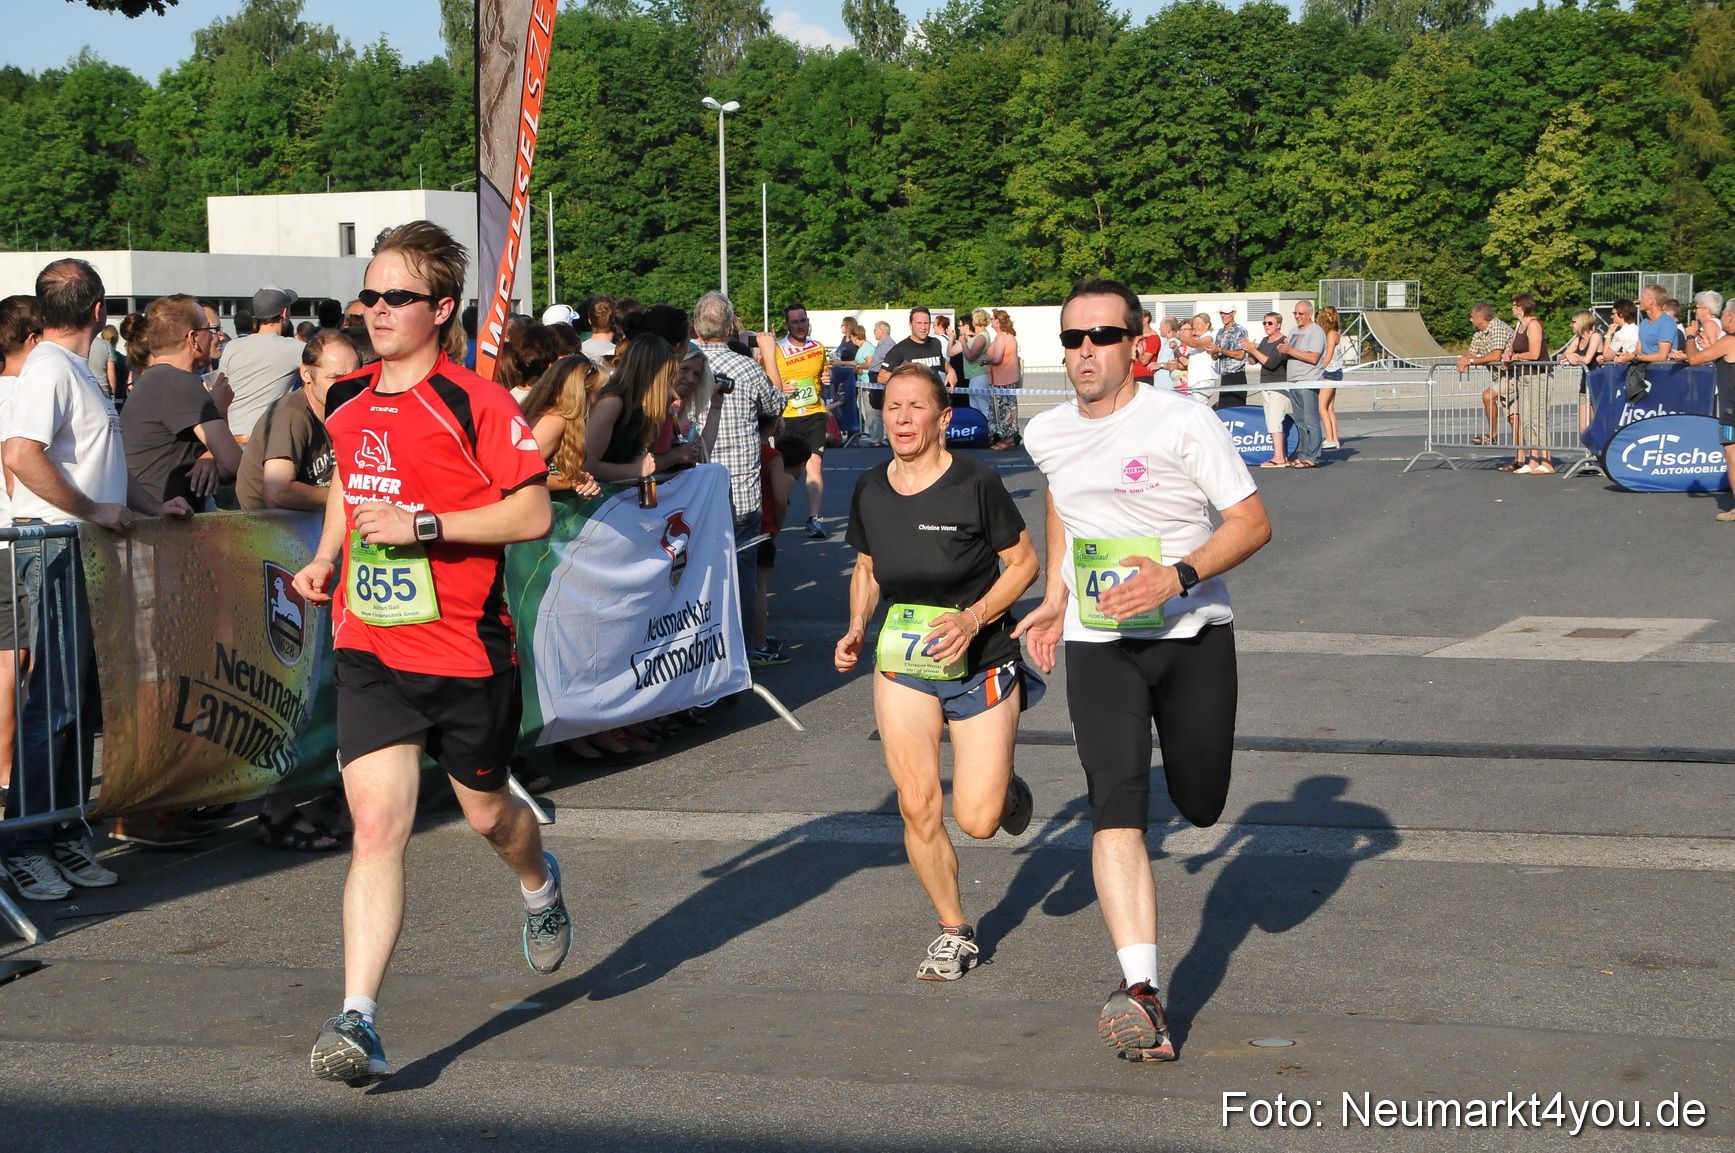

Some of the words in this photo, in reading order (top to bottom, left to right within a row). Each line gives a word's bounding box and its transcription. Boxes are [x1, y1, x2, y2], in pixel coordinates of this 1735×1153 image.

[785, 356, 806, 367] MAX
[946, 425, 978, 439] cher
[1233, 431, 1274, 446] sche
[1237, 445, 1274, 453] TOMOBIL
[1642, 447, 1726, 467] Fische
[347, 473, 402, 495] MEYER
[356, 564, 417, 604] 855
[1085, 569, 1139, 604] 42
[644, 599, 712, 644] Neumarkter
[629, 627, 727, 691] Lammsbräu
